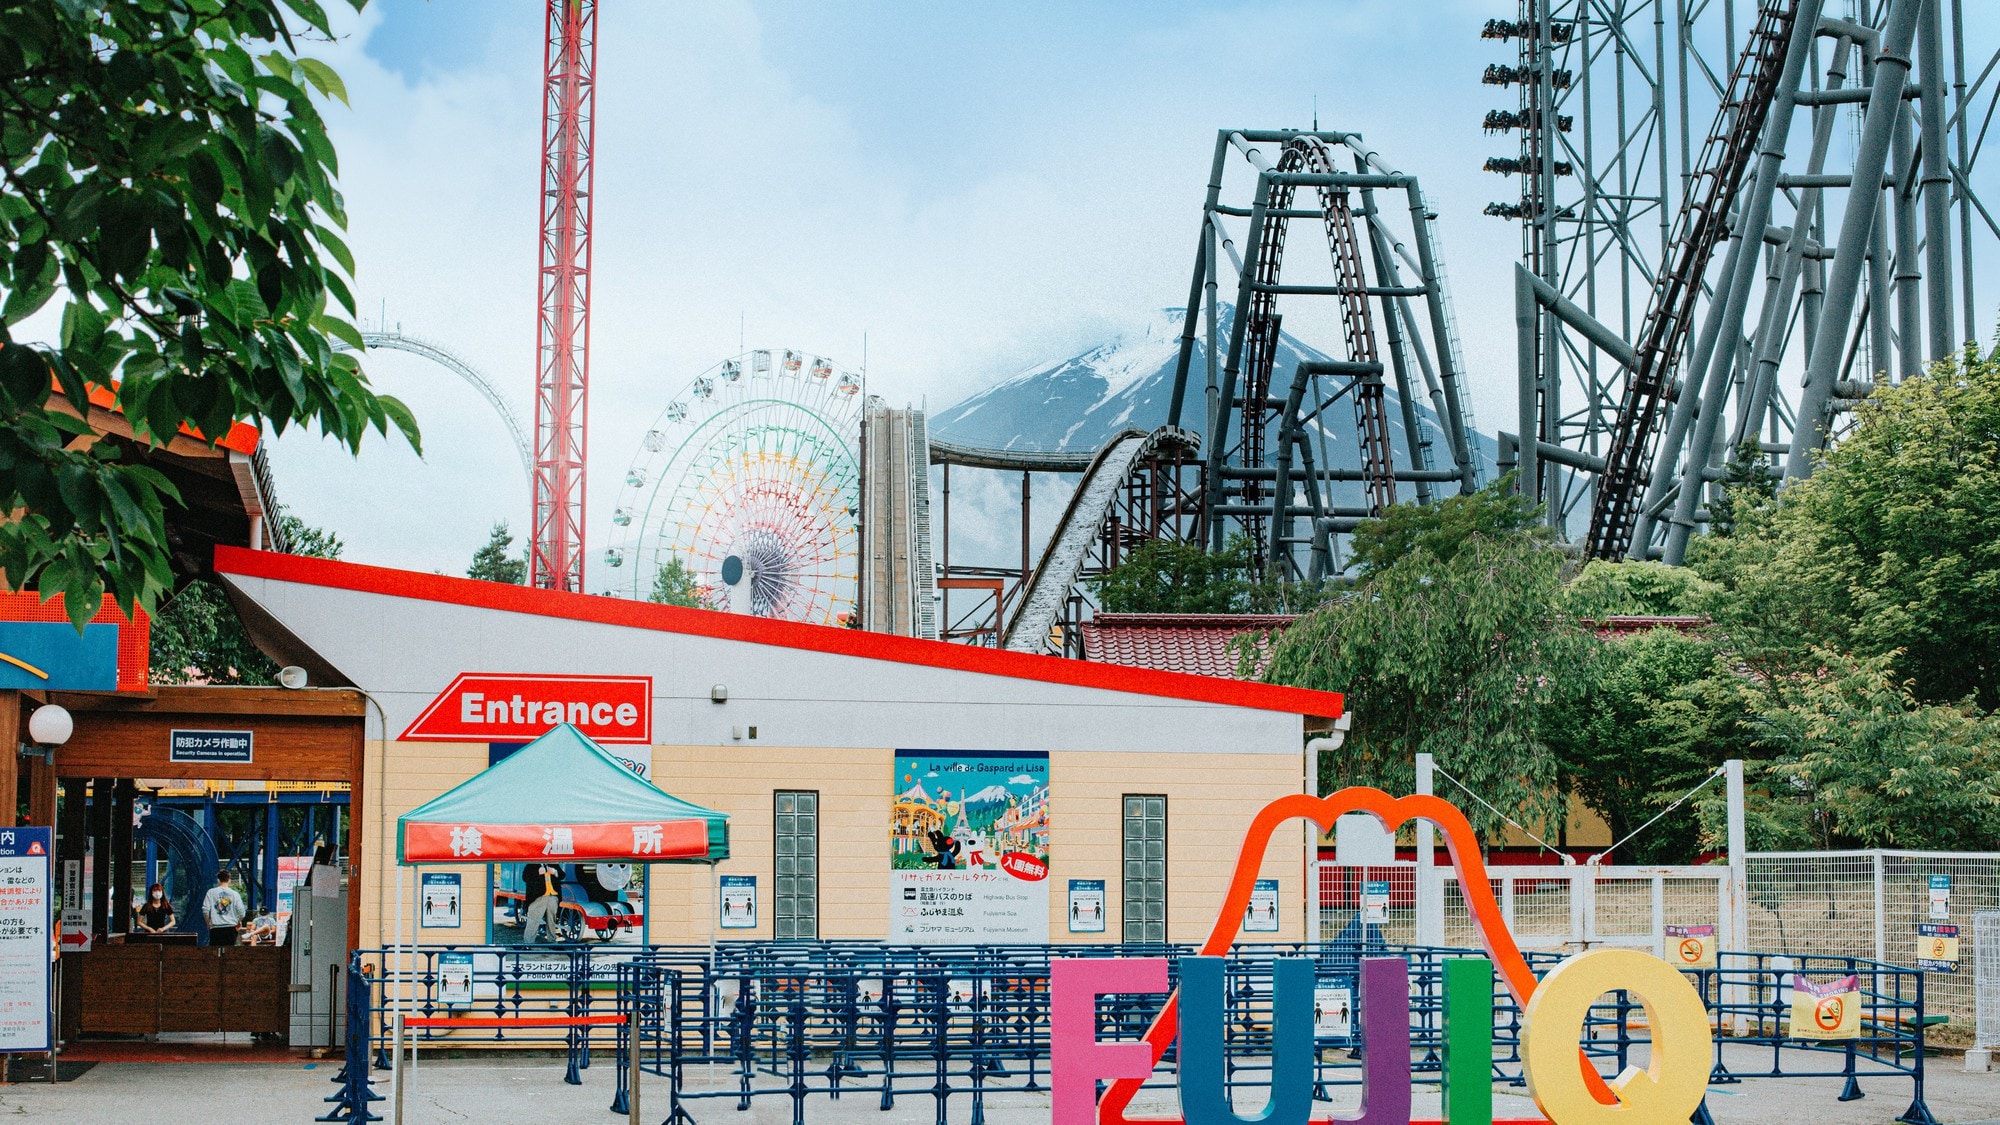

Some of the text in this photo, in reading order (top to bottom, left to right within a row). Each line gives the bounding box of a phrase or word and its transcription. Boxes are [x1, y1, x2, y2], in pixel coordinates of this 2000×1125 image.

[461, 692, 638, 727] Entrance
[175, 736, 248, 749] 防犯カメラ作動中
[929, 762, 940, 772] La
[943, 762, 963, 772] ville
[964, 763, 975, 773] de
[977, 762, 1014, 775] Gaspard
[1026, 763, 1045, 773] Lisa
[1003, 856, 1045, 879] 入園無料
[919, 892, 973, 901] 高速バスのりば
